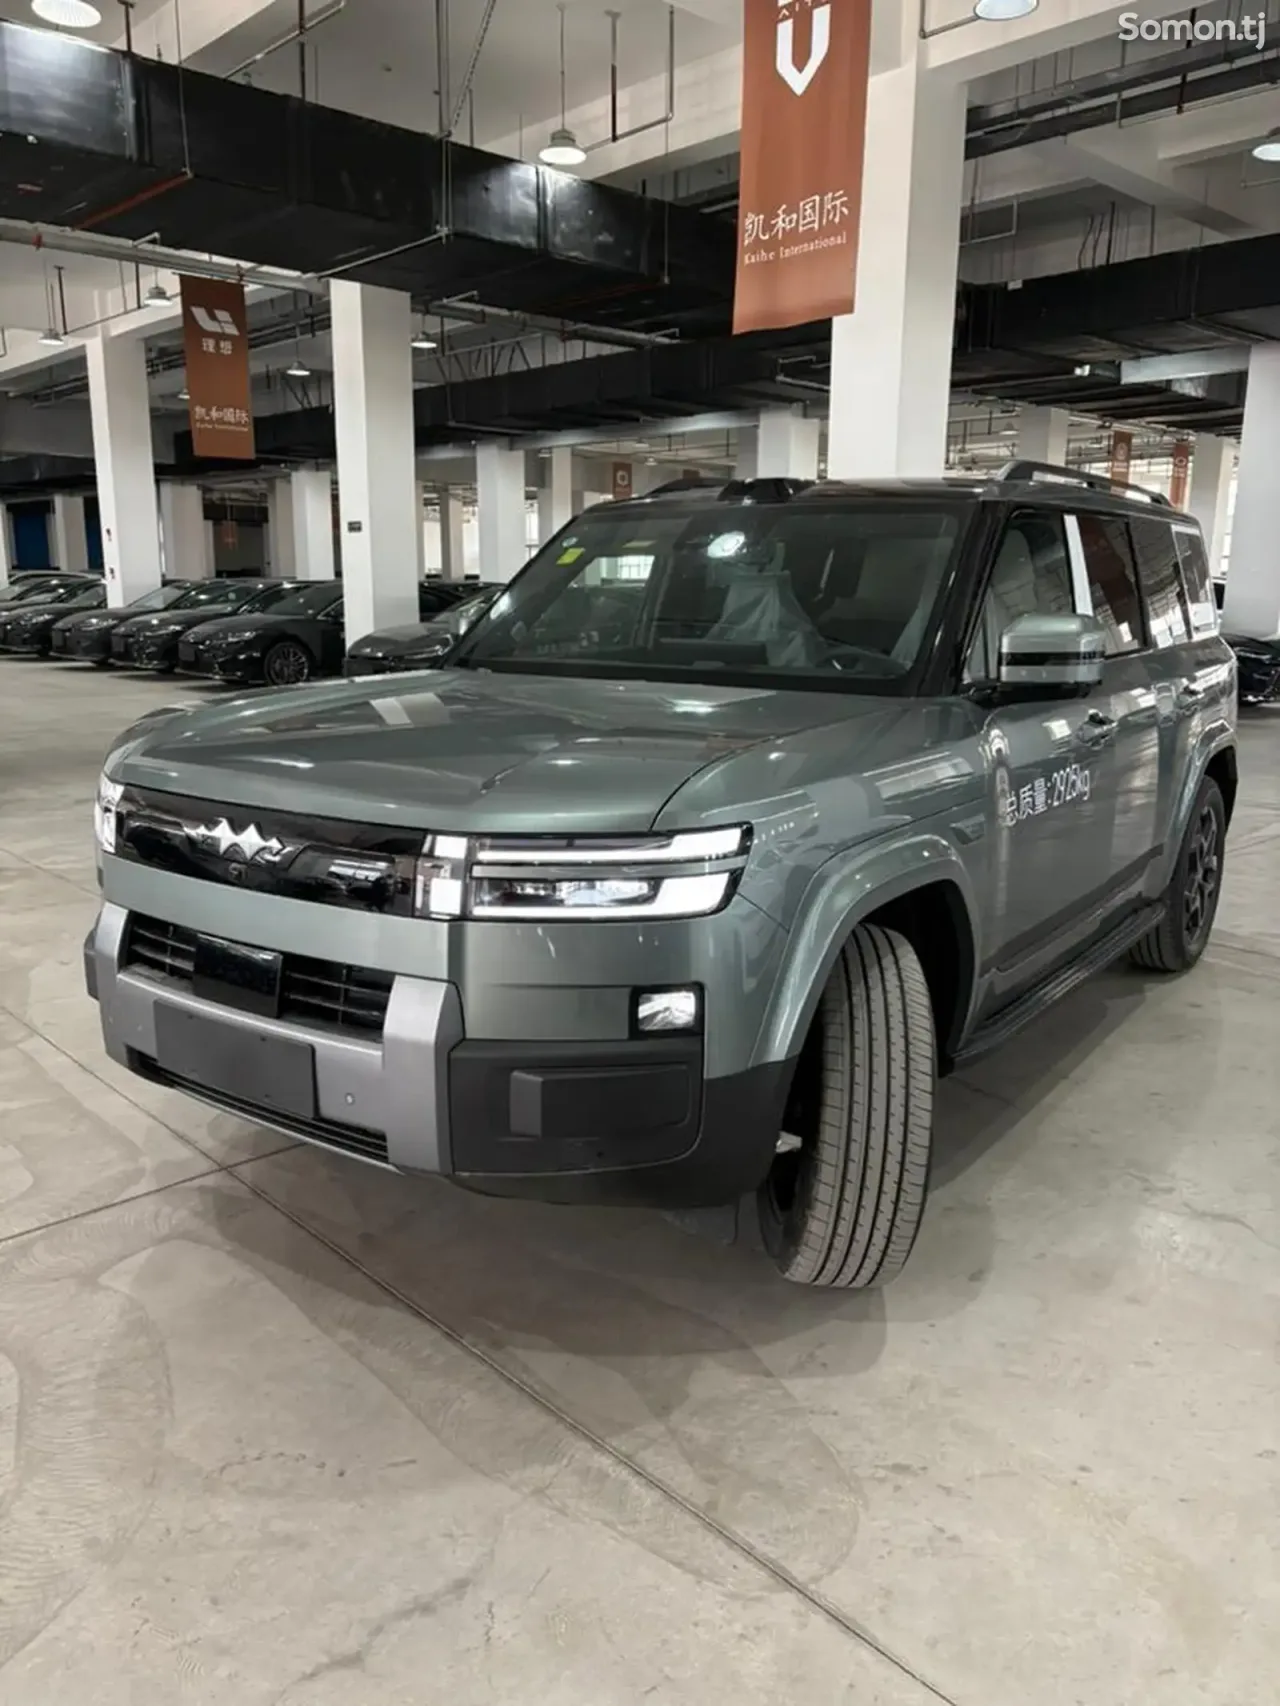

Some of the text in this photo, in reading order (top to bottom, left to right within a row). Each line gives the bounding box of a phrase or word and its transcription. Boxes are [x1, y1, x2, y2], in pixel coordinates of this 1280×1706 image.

[744, 190, 849, 247] 凯和国际
[744, 231, 847, 266] Kaihe International
